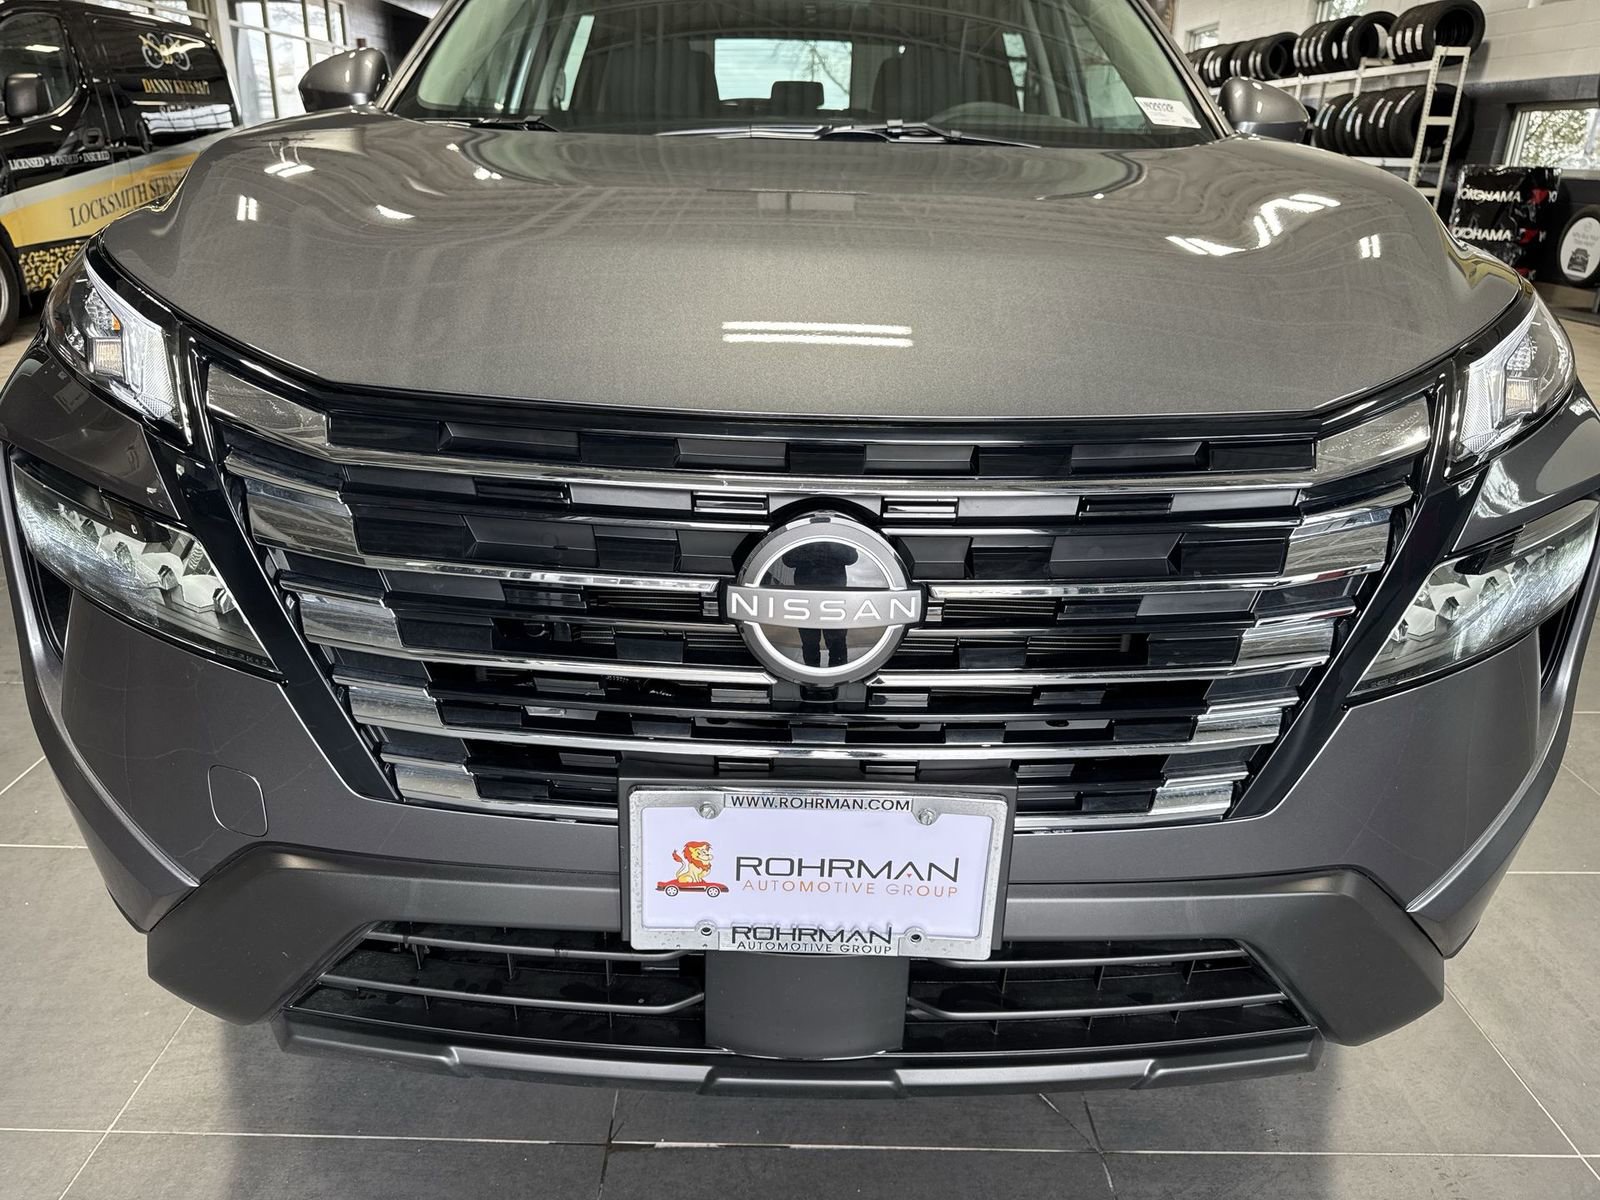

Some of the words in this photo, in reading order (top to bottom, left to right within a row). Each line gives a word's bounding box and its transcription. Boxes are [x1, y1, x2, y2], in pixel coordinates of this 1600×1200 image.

[142, 79, 174, 94] DANNY
[8, 157, 45, 171] LICENSED
[69, 183, 149, 228] LOCKSMITH
[731, 593, 916, 621] NISSAN
[731, 795, 910, 812] WWW.ROHRMAN.COM
[736, 856, 959, 883] ROHRMAN
[742, 879, 875, 895] AUTOMOTIVE
[885, 883, 958, 898] GROUP
[731, 926, 892, 945] ROHRMAN
[736, 941, 833, 953] AUTOMOTIVE
[839, 943, 892, 955] GROUP
